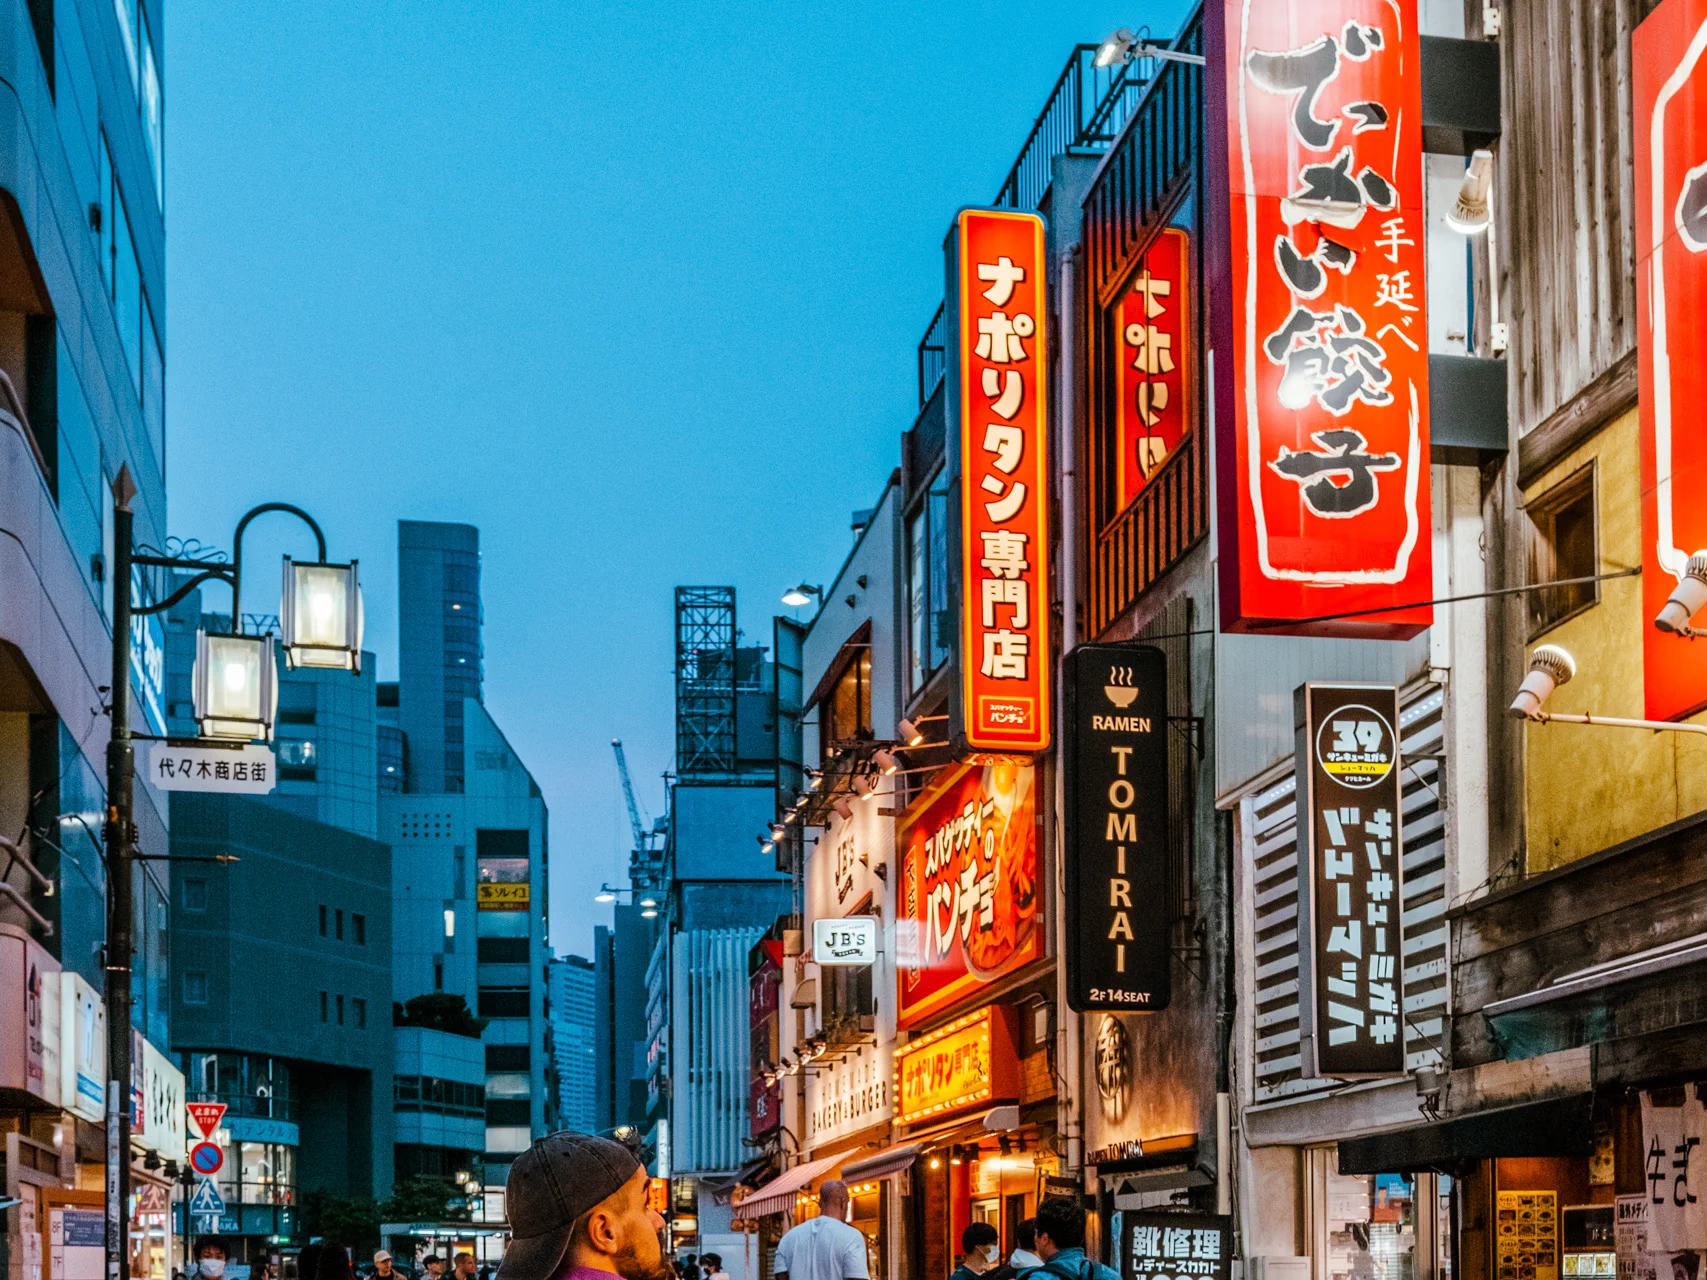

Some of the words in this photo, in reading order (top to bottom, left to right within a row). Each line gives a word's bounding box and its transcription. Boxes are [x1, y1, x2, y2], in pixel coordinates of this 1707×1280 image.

[1246, 20, 1398, 519] でっかい餃子
[1373, 217, 1420, 351] 手延べ
[974, 256, 1036, 681] ナポリタン専門店
[1092, 715, 1151, 733] RAMEN
[1332, 720, 1383, 753] 39
[158, 757, 267, 782] 代々木商店街
[1105, 745, 1138, 973] TOMIRAI
[924, 857, 998, 964] パンチョ
[824, 931, 867, 950] JB'S
[1089, 988, 1106, 1001] 2F
[905, 1041, 979, 1100] ナポリタン専門店
[195, 1107, 219, 1116] 止まれ
[198, 1116, 216, 1125] STOP
[812, 1099, 843, 1134] BAKERY
[850, 1080, 887, 1120] BURGER
[1132, 1226, 1221, 1260] 靴修理
[1132, 1258, 1221, 1274] レディースカカト
